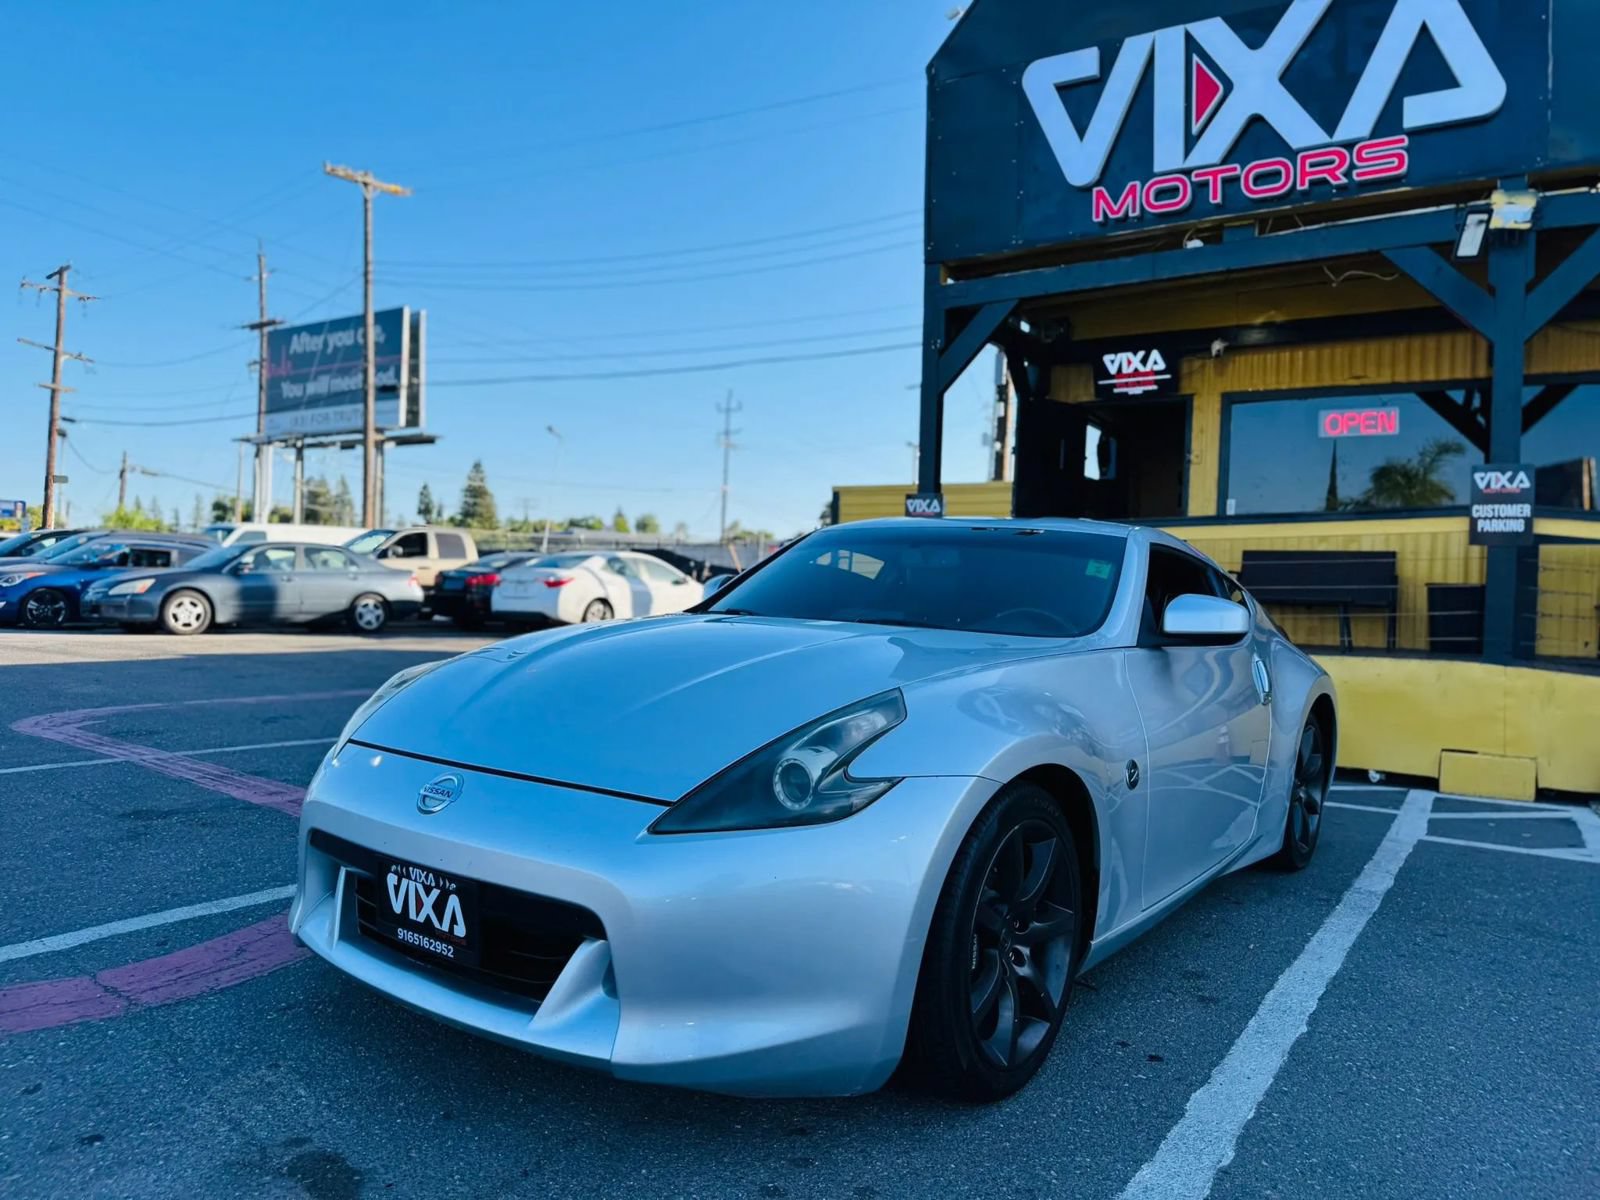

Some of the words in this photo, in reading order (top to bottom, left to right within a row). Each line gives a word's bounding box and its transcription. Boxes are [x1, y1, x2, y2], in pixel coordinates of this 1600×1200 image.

[1021, 0, 1507, 188] VIXA
[1092, 135, 1409, 223] MOTORS
[289, 331, 323, 355] After
[326, 329, 355, 355] you
[1102, 348, 1167, 376] VIXA
[281, 380, 304, 399] You
[305, 373, 330, 397] will
[1323, 409, 1396, 436] OPEN
[1473, 470, 1531, 490] VIXA
[906, 498, 941, 513] VIXA
[1471, 504, 1531, 518] CUSTOMER
[1477, 518, 1525, 533] PARKING
[423, 785, 454, 799] NISSAN
[408, 866, 436, 888] VIXA
[386, 872, 466, 938] VIXA
[397, 927, 455, 958] 9165162952
